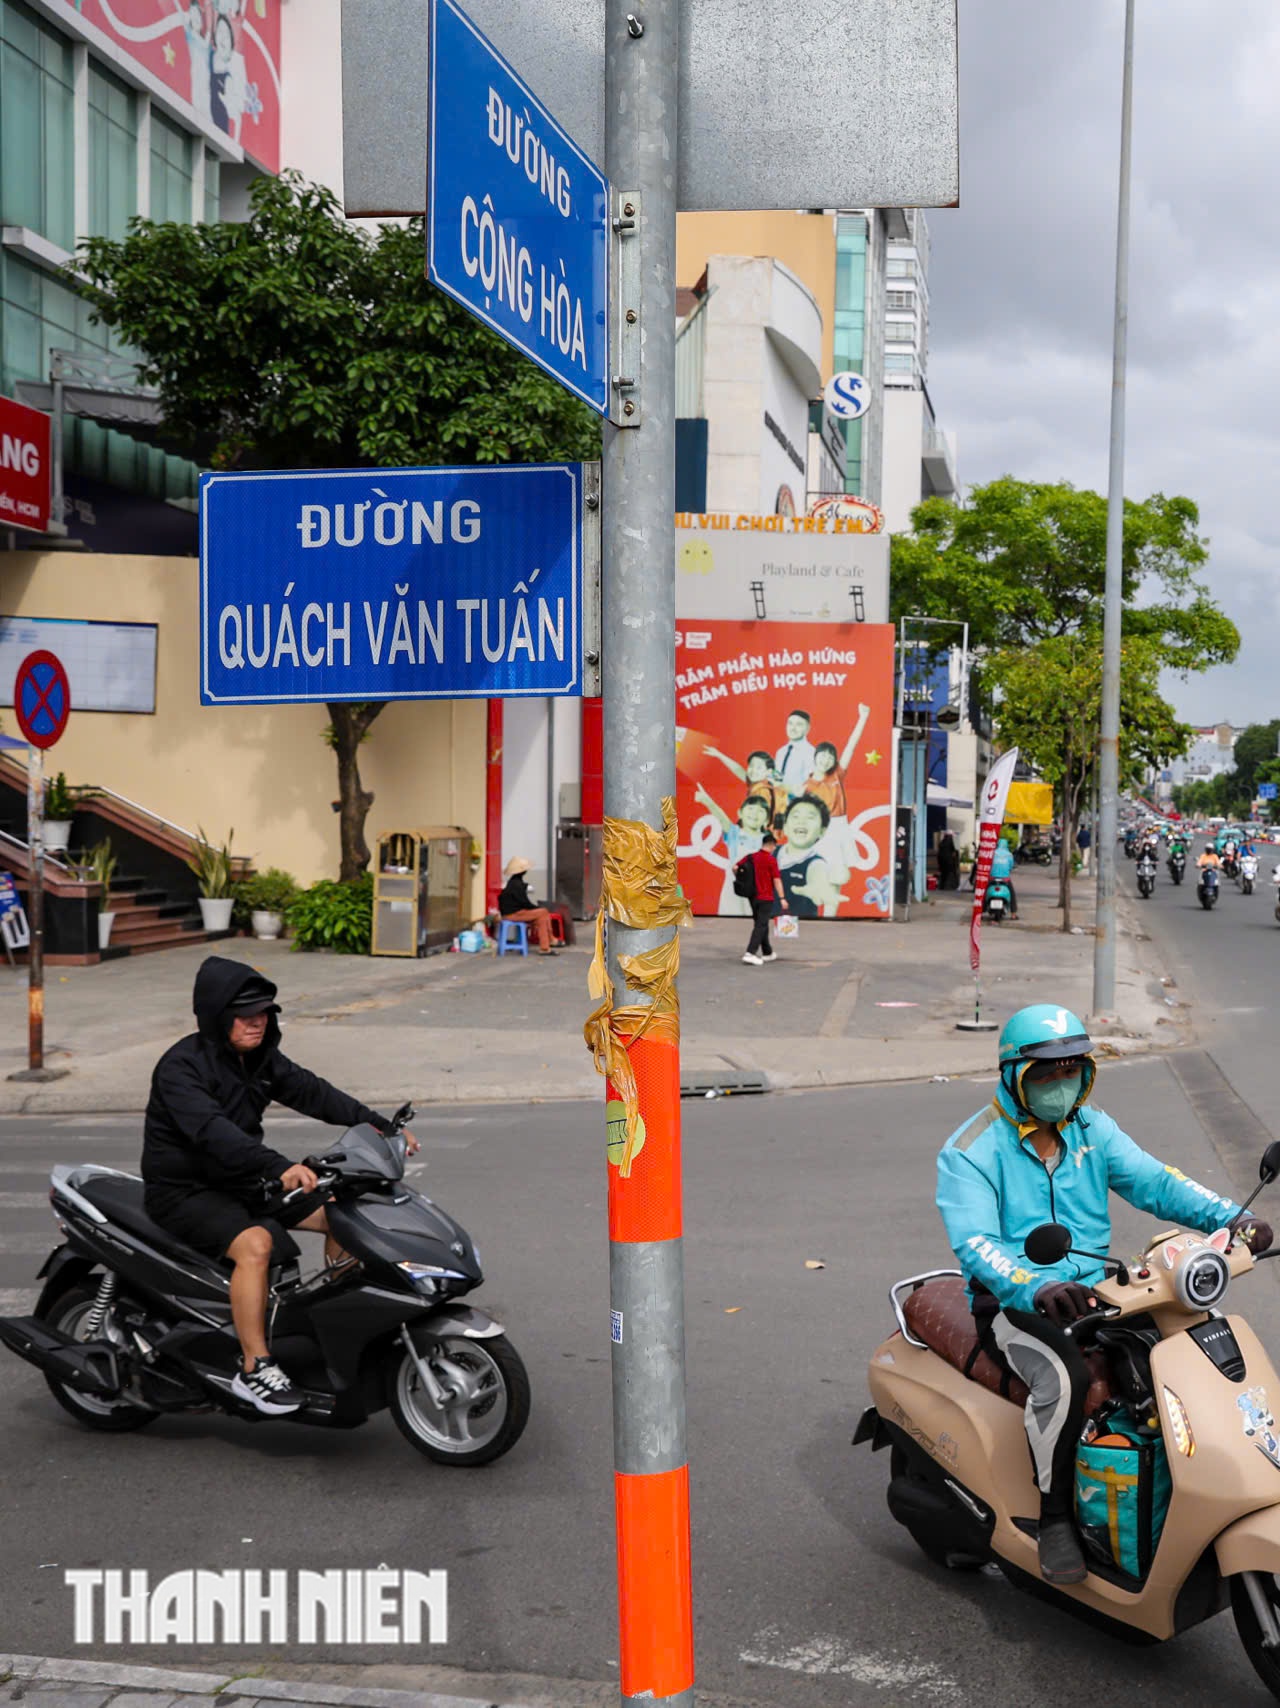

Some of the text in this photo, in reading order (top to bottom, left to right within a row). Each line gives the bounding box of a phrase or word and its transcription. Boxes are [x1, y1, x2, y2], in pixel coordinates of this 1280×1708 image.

[486, 85, 571, 218] ĐƯỜNG
[460, 193, 587, 372] CỘNG HÒA
[0, 432, 40, 478] NG
[296, 487, 481, 549] ĐƯỜNG
[761, 562, 817, 579] Playland
[835, 563, 865, 578] Cafe
[218, 568, 565, 669] QUÁCH VĂN TUẤN
[675, 665, 714, 692] RĂM
[767, 648, 804, 668] HÀO
[680, 682, 728, 710] TRĂM
[812, 671, 848, 687] HAY
